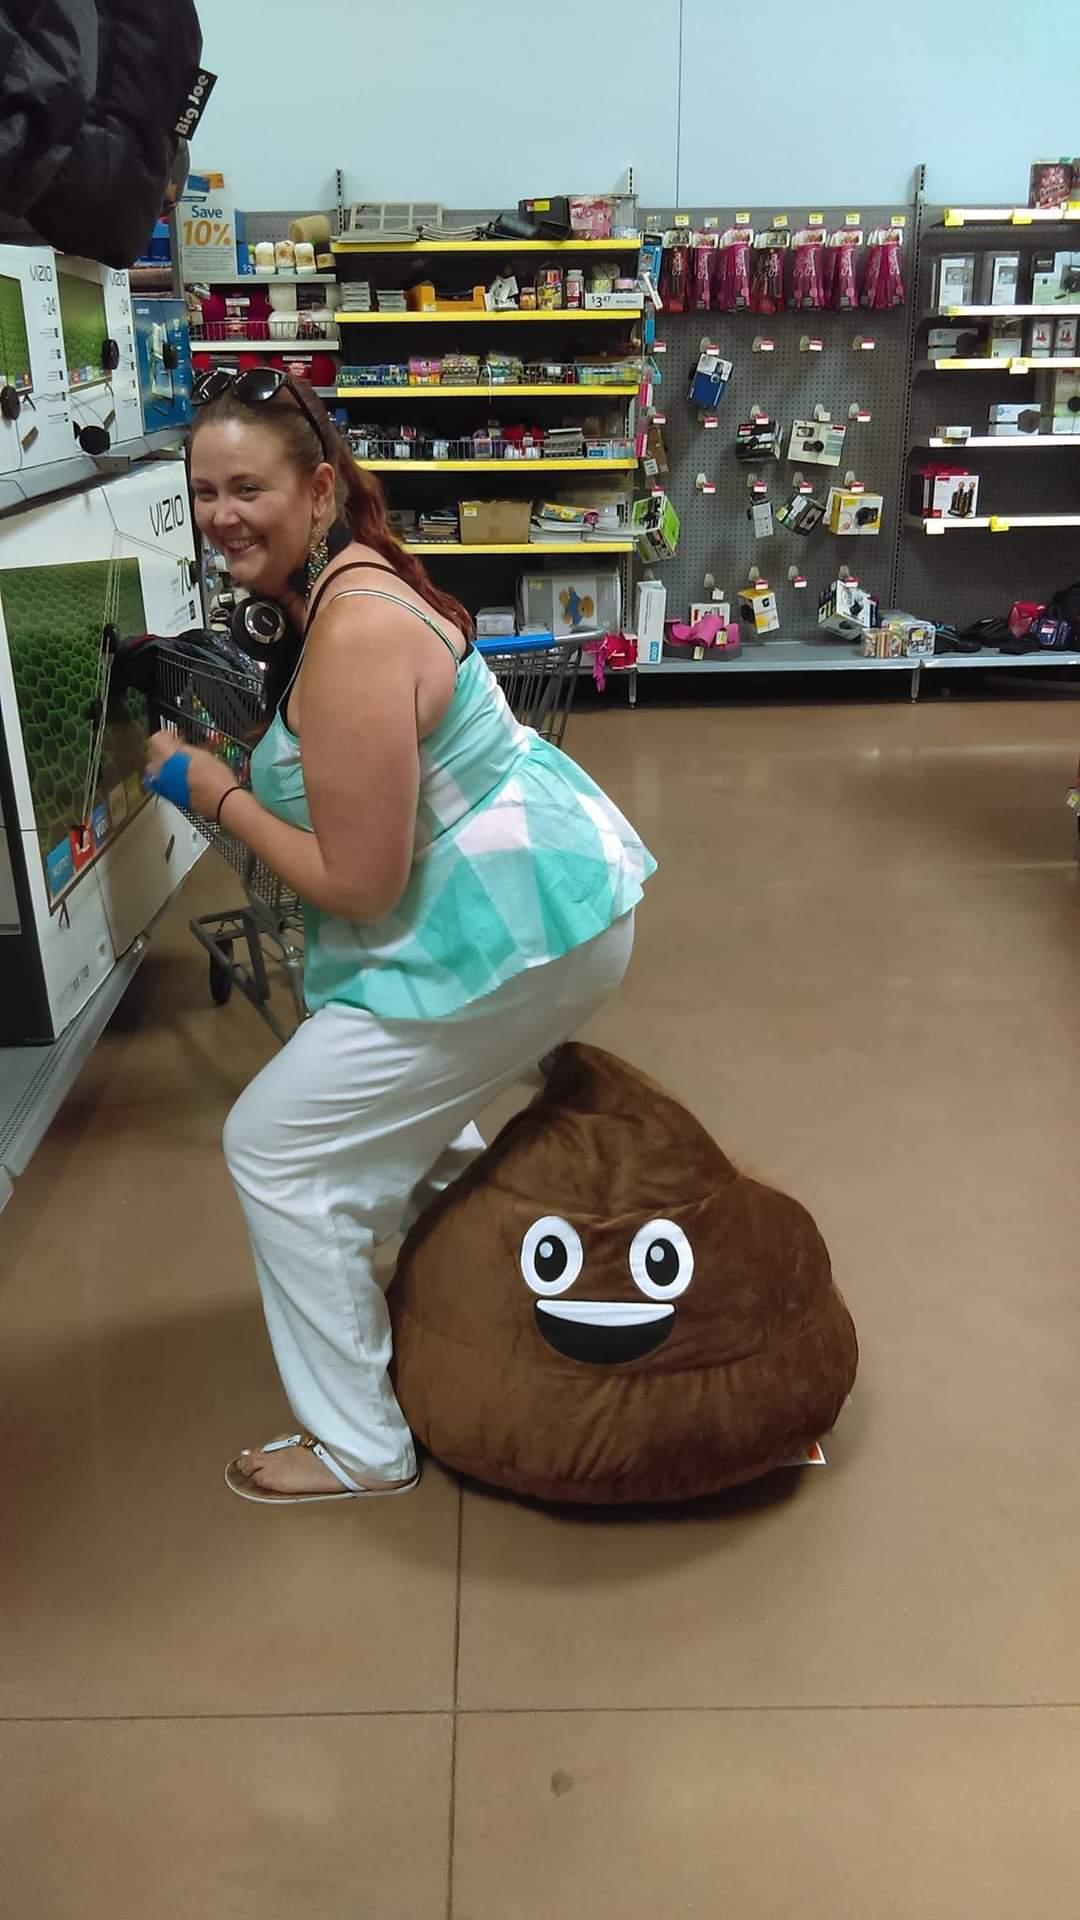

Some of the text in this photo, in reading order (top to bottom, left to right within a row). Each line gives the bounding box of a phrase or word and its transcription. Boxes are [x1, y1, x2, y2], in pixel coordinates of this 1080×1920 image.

[174, 74, 209, 135] Big Joe
[191, 205, 223, 218] Save
[183, 220, 231, 246] 10%
[30, 264, 53, 282] VIZIO
[149, 494, 185, 537] VIZIO
